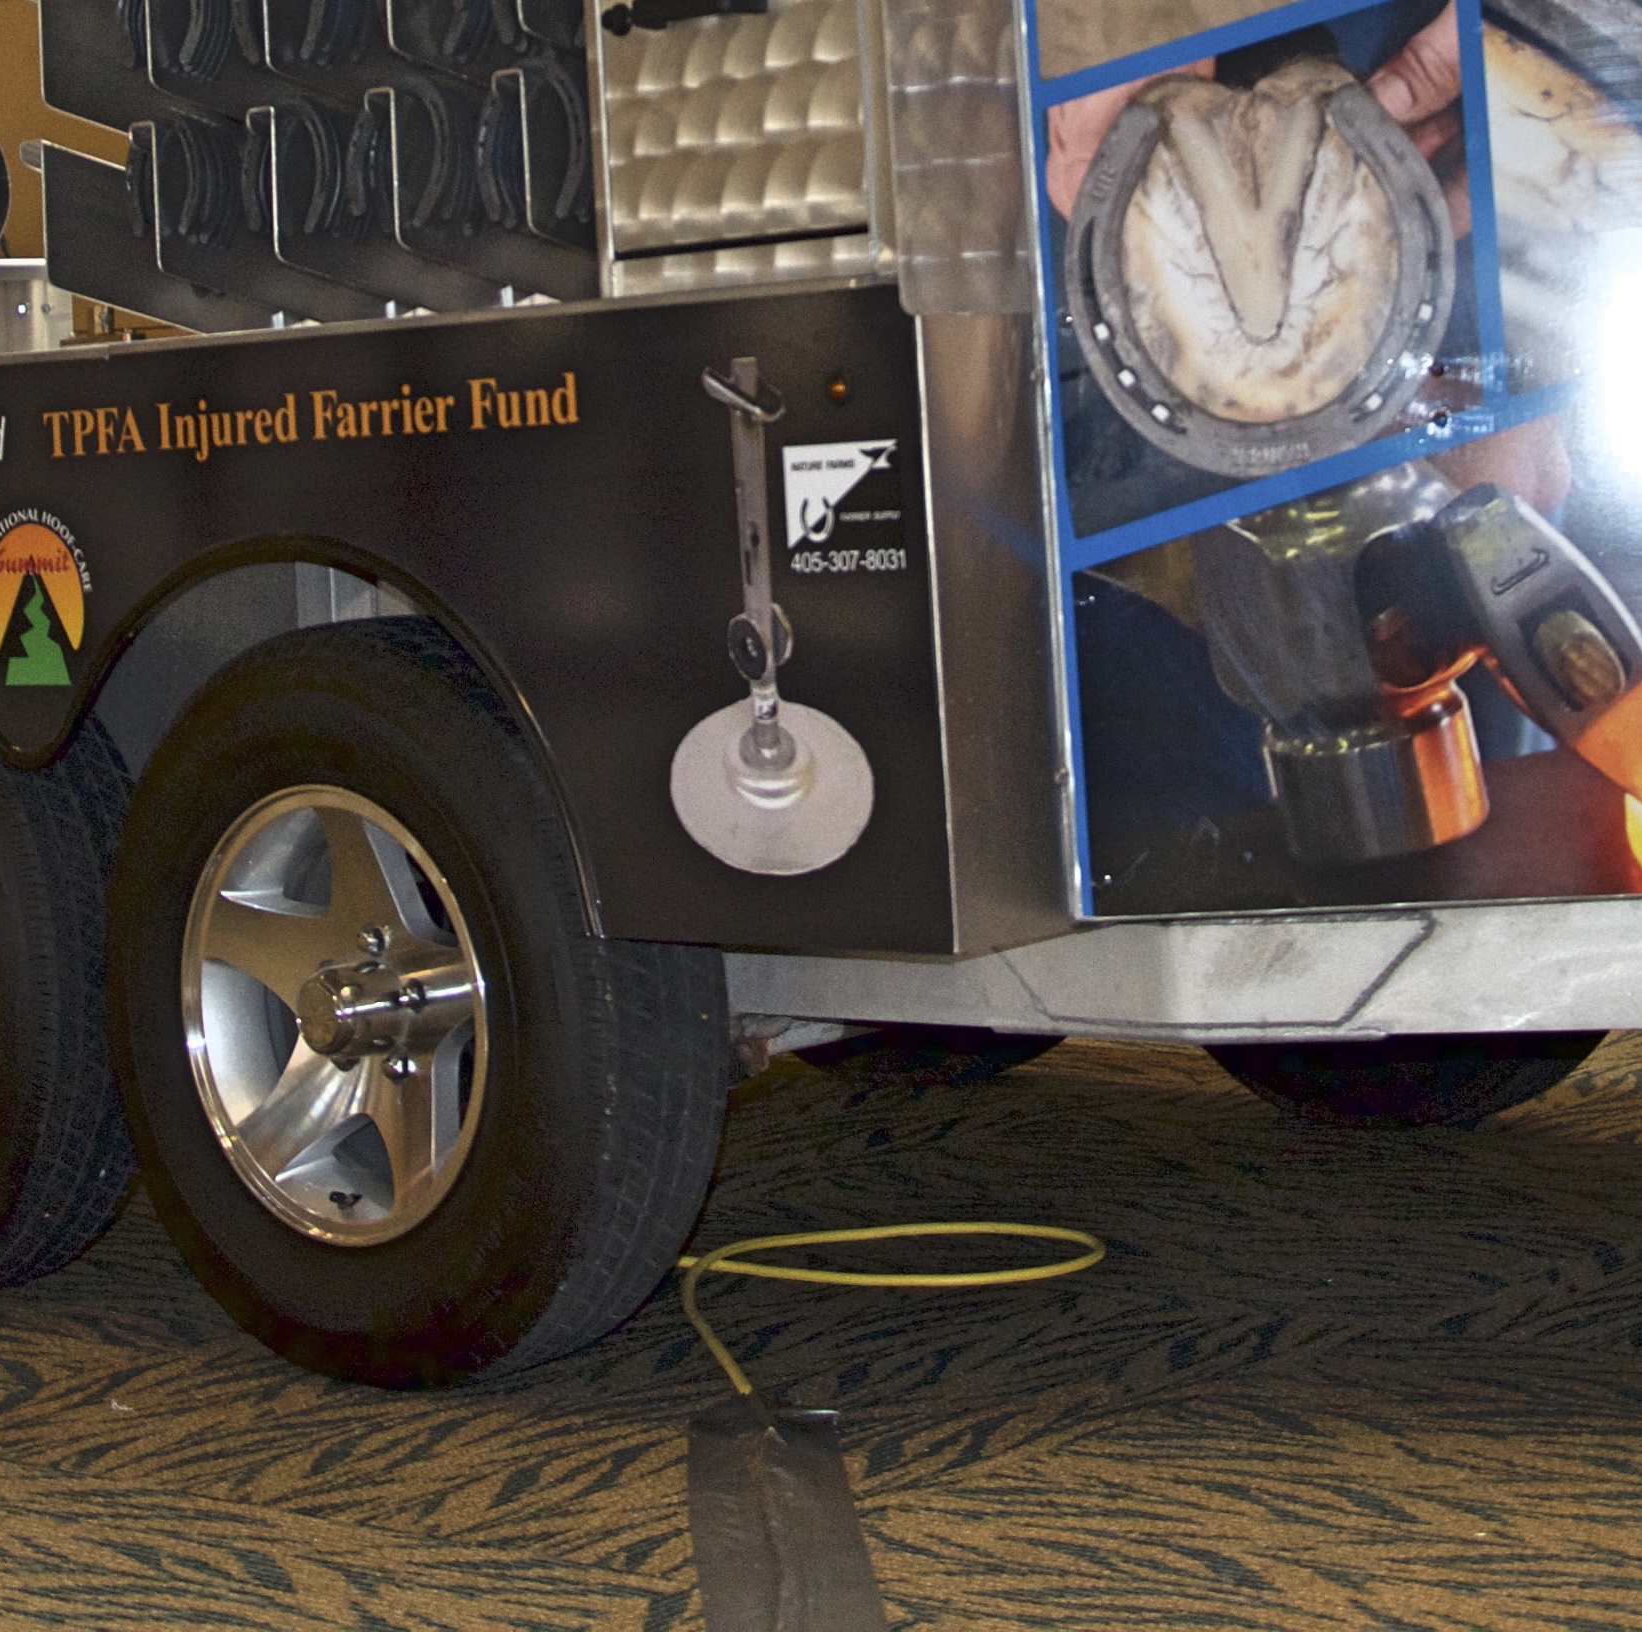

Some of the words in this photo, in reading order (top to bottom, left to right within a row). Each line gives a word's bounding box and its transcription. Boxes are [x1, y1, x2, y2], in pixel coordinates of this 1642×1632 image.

[43, 404, 147, 459] TPFA
[156, 393, 300, 463] Injured
[309, 382, 456, 441] Farrier
[468, 371, 581, 431] Fund
[41, 510, 94, 593] HOOF-CARE
[790, 547, 907, 574] 405-307-8031
